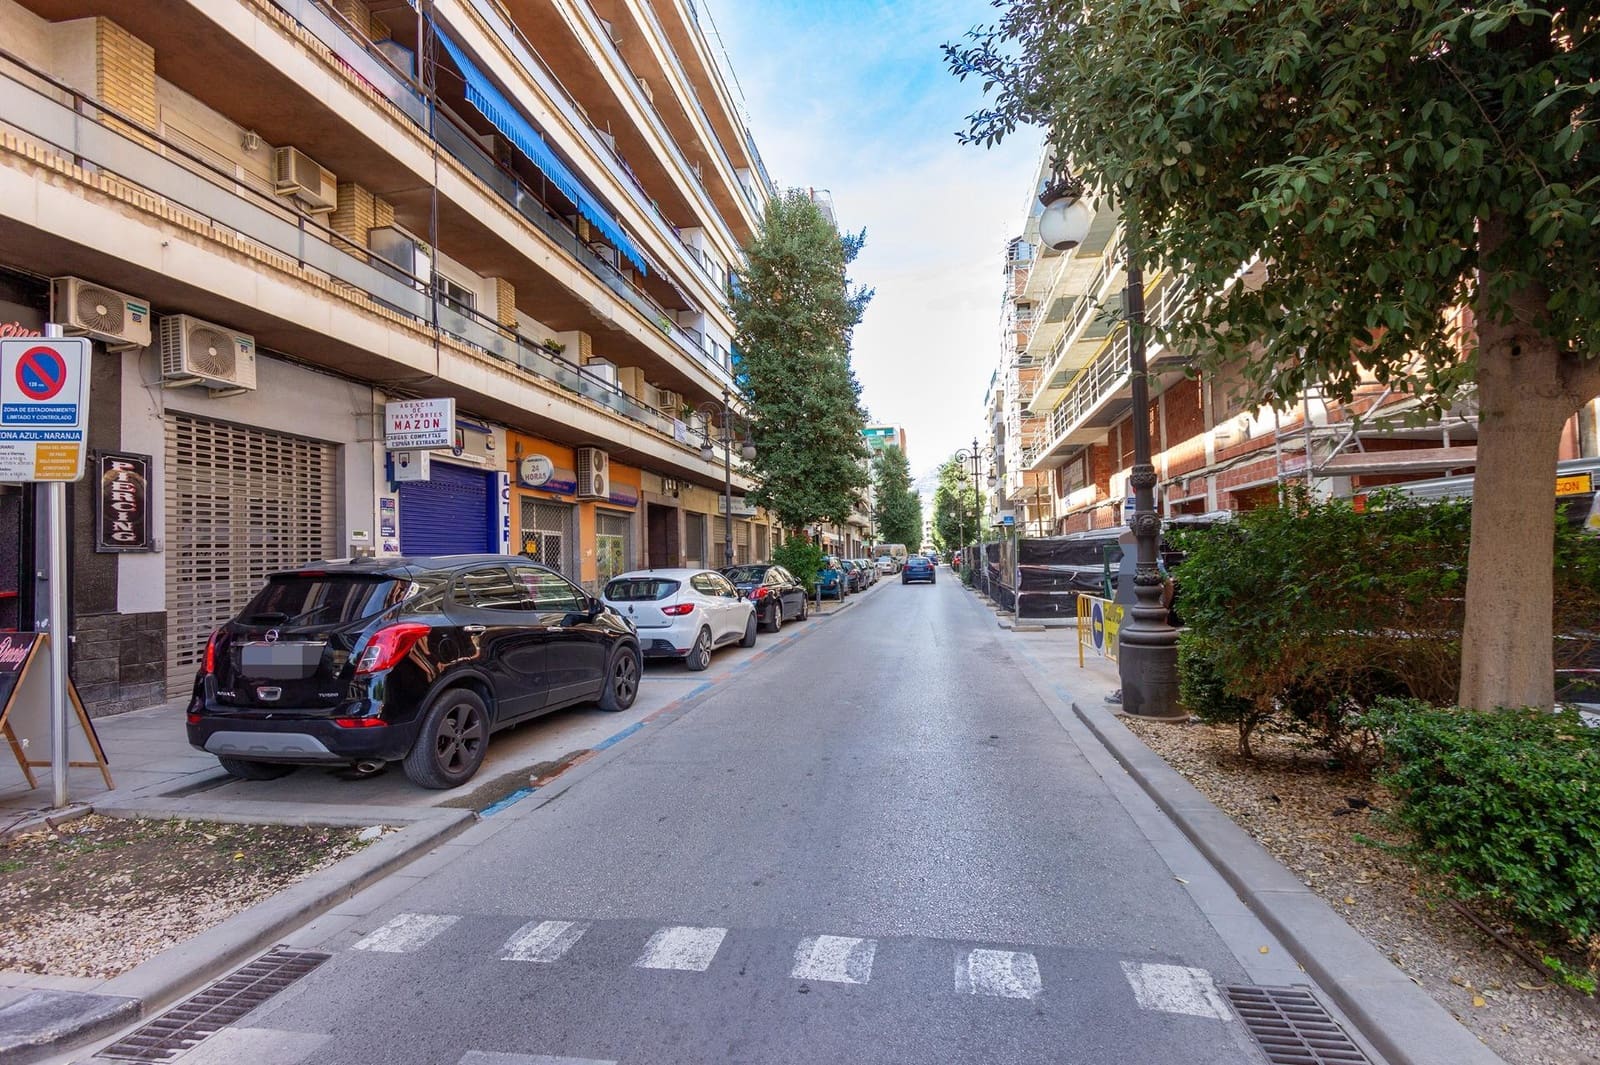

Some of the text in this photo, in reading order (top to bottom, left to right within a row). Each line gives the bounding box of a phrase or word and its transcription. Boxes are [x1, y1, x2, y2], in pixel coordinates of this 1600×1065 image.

[394, 419, 440, 430] MAZON
[44, 432, 81, 440] NARANJA
[531, 464, 540, 472] 24
[525, 472, 547, 481] HORAS
[111, 460, 137, 542] PIERCING
